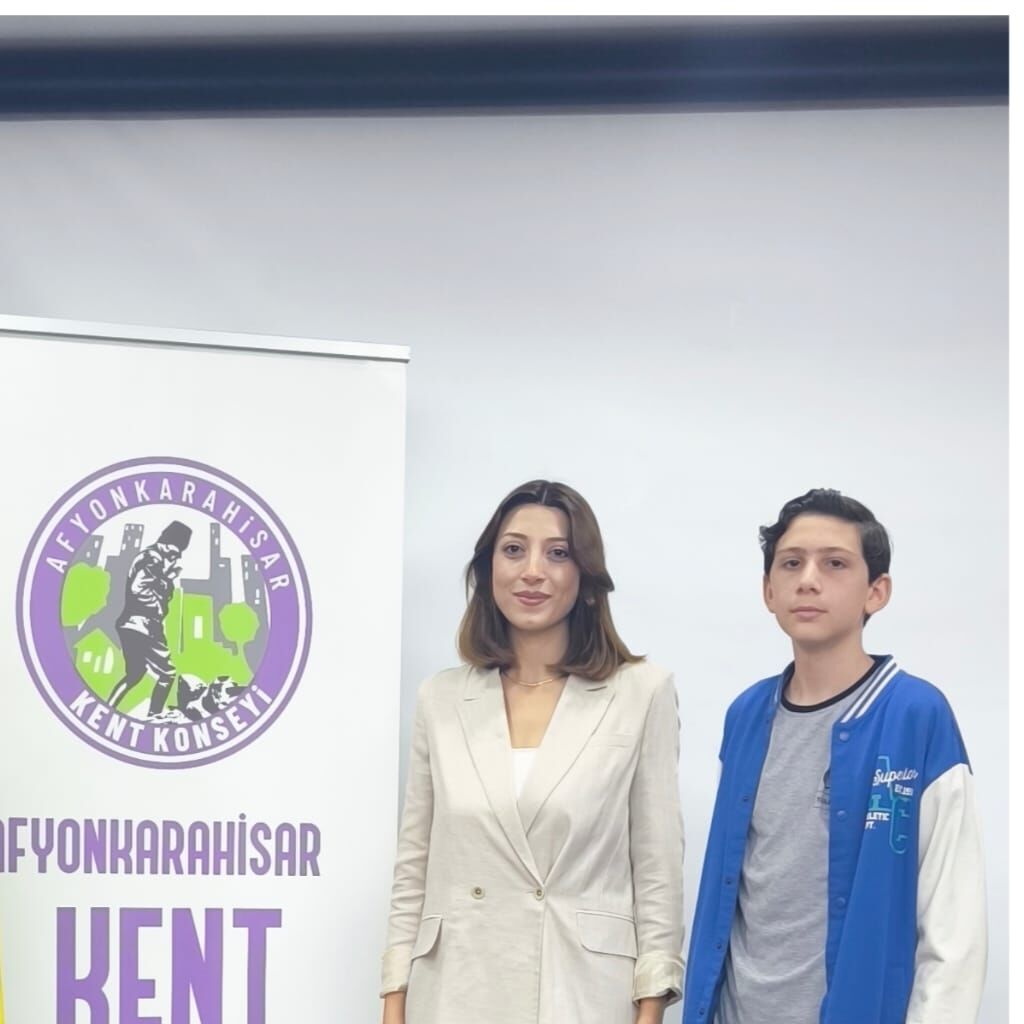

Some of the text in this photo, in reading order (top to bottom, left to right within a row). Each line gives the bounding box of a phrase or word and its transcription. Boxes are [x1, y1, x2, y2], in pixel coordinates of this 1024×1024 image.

[46, 478, 290, 591] AFYONKARAHİSAR
[70, 684, 273, 753] KENT KONSEYİ
